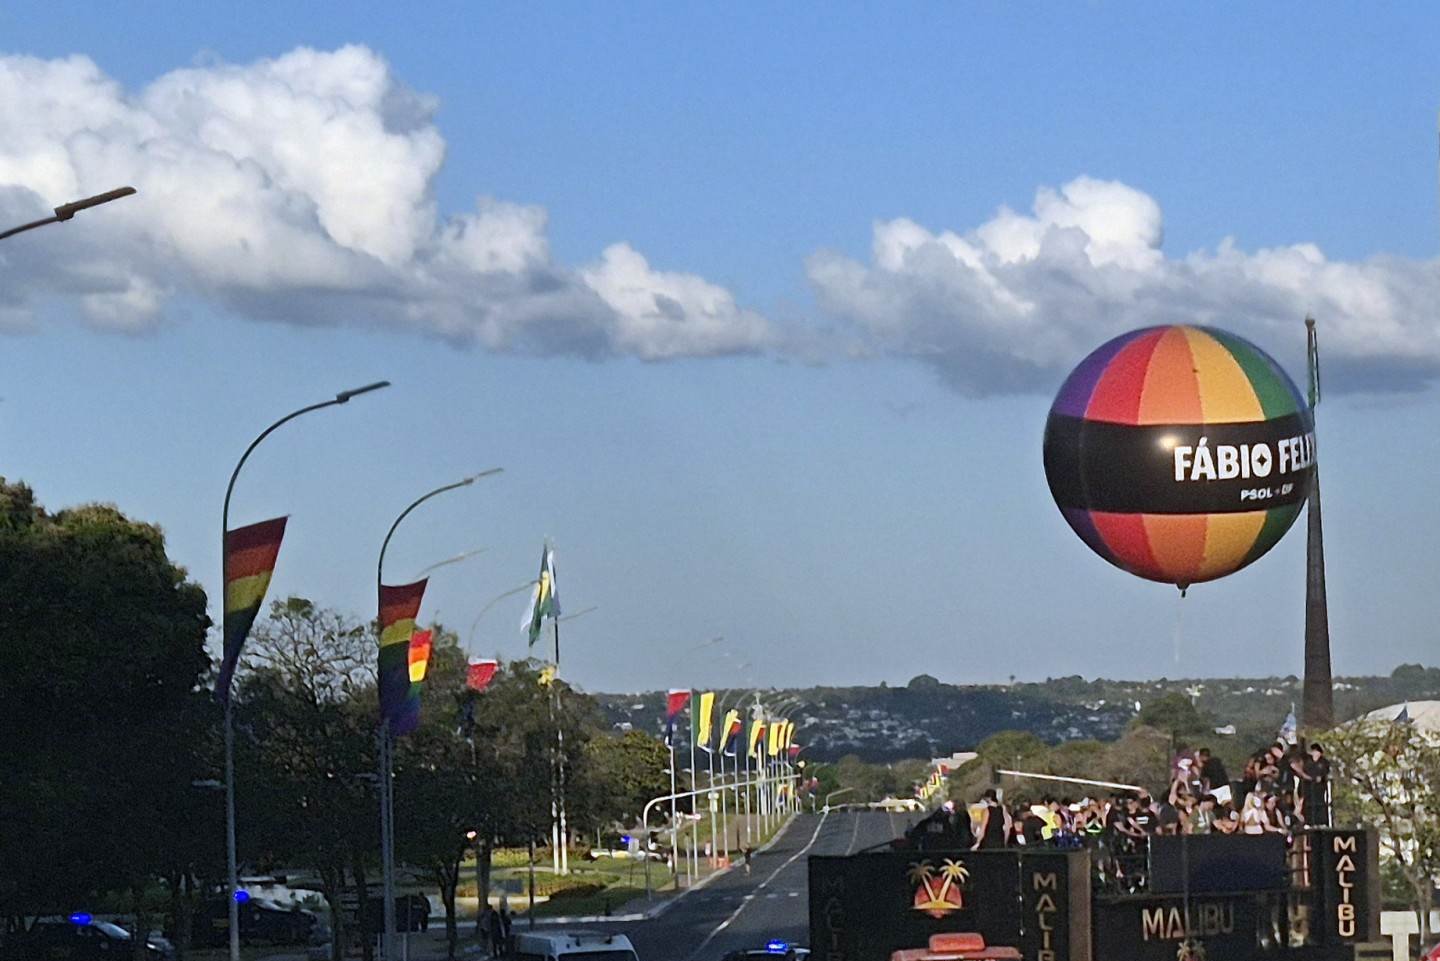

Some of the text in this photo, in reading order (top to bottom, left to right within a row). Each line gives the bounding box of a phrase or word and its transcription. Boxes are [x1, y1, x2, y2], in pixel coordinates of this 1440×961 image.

[1174, 436, 1272, 482] FÁBIO
[1240, 486, 1273, 501] PSOL
[1333, 836, 1357, 937] MALIBU
[1142, 902, 1234, 941] MALIBU
